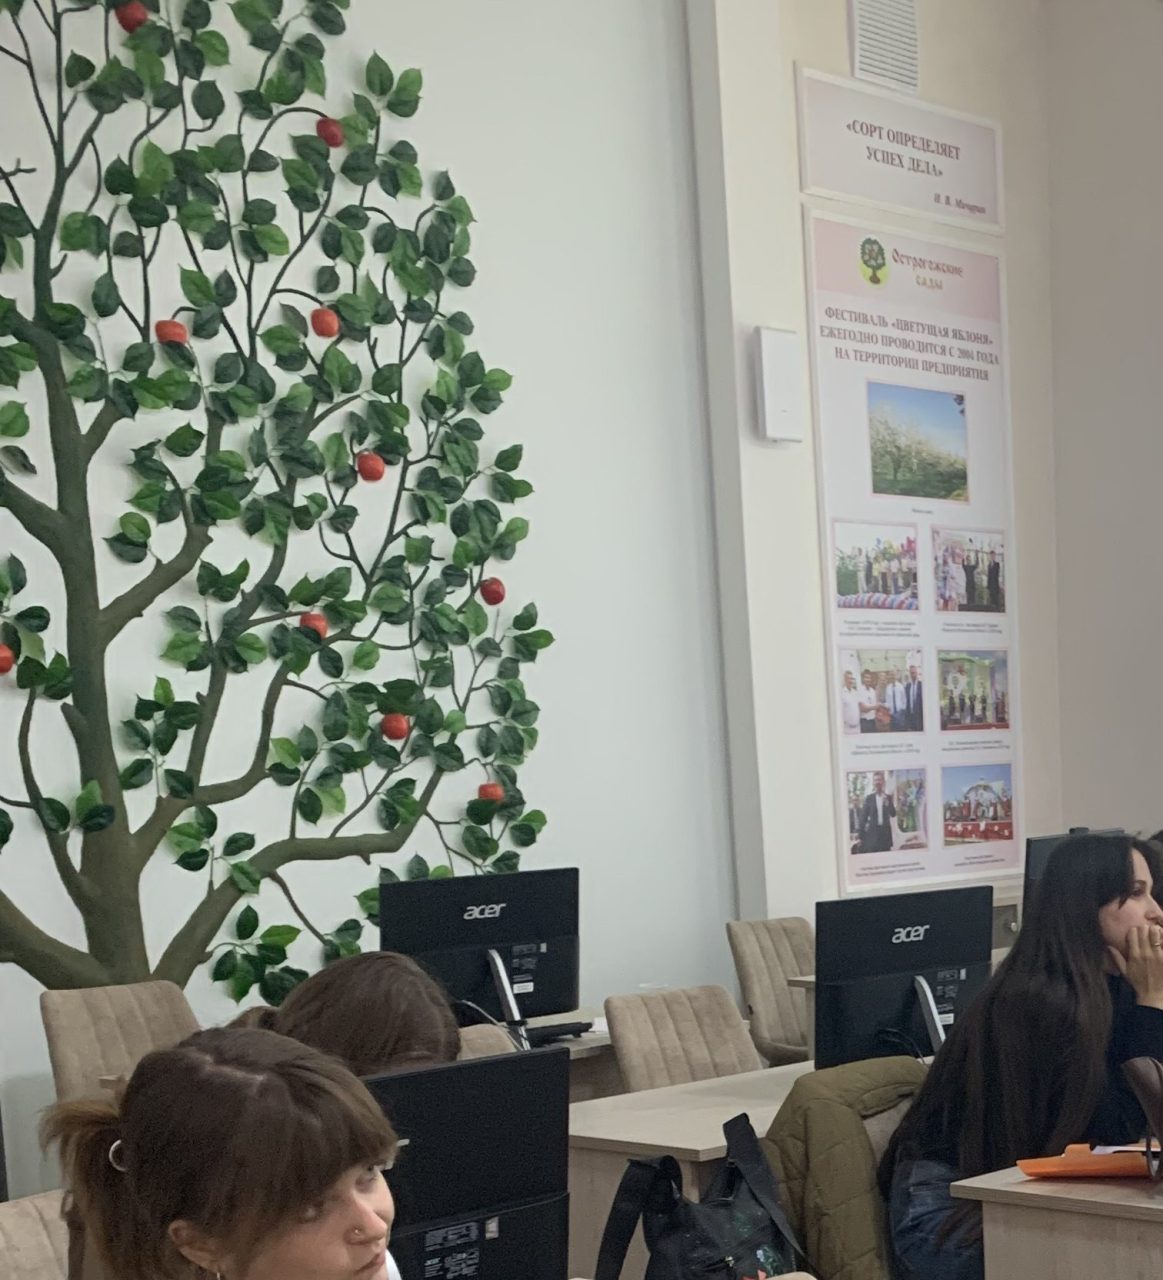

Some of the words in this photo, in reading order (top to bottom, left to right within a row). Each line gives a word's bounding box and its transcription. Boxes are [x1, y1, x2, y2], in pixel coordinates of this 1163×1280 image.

[887, 129, 961, 160] ОПРЕДЕЛЯЕТ
[866, 146, 904, 168] УСПЕХ
[825, 306, 888, 328] ФЕСТИВАЛЬ
[820, 325, 879, 346] ЕЖЕГОДНО
[881, 335, 947, 357] ПРОВОДИТСЯ
[976, 351, 1000, 365] ГОДА
[834, 346, 850, 360] НА
[853, 349, 919, 371] ТЕРРИТОРИИ
[921, 359, 990, 382] ПРЕДПРИЯТИЯ
[463, 903, 507, 920] acer
[891, 924, 930, 943] acer
